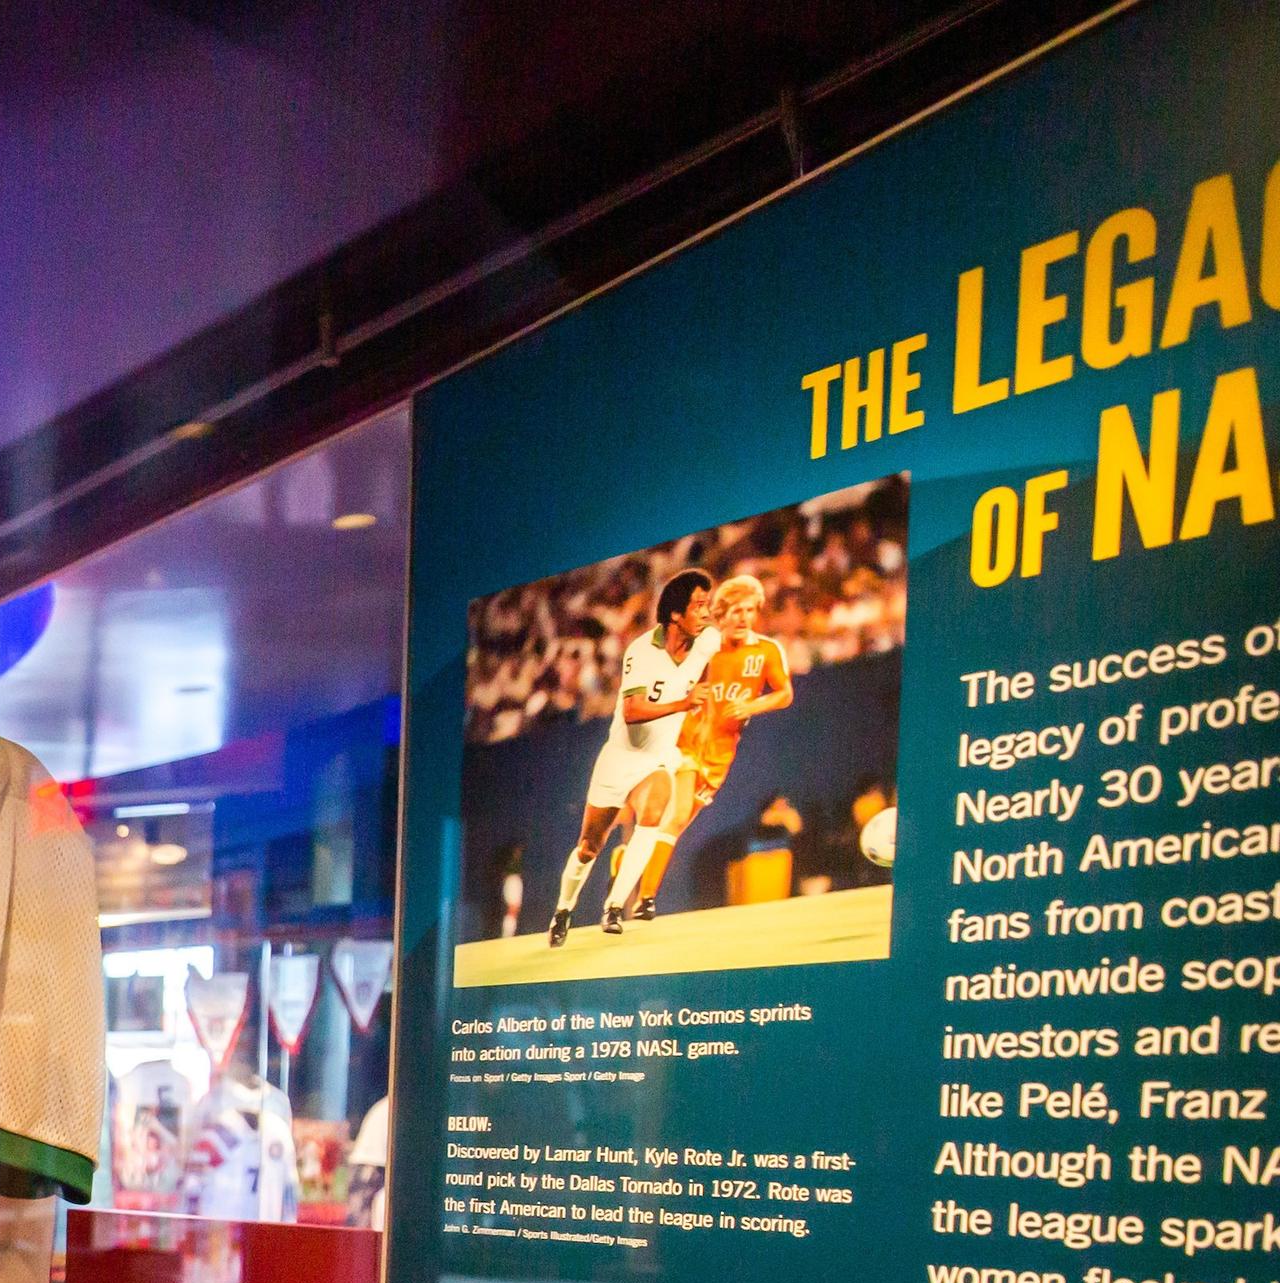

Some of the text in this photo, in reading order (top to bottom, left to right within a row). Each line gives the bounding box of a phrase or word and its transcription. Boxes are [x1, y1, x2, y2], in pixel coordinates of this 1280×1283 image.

[800, 160, 1280, 460] THE LEGA
[970, 367, 1279, 588] OF NA
[648, 681, 665, 702] 5
[960, 671, 1035, 707] The
[1049, 635, 1227, 692] success
[958, 685, 1280, 770] legacy of profe
[956, 756, 1280, 827] Nearly 30 year
[952, 844, 1063, 885] North
[948, 909, 1030, 943] fans
[1045, 899, 1143, 936] from
[945, 956, 1165, 1002] nationwide
[451, 1003, 812, 1035] Carlos Alberto of the New York Cosmos sprints
[942, 1023, 1120, 1059] investors
[1134, 1015, 1221, 1057] and
[451, 1039, 739, 1063] into action during a 1978 NASL game.
[447, 1116, 492, 1132] BELOW:
[940, 1080, 1268, 1125] like Pelé, Franz
[447, 1143, 856, 1171] Discovered by Lamar Hunt, Kyle Rote Jr. was a first-
[934, 1141, 1112, 1188] Although
[1128, 1145, 1202, 1184] the
[445, 1171, 853, 1204] round pick by the Dallas Tornado in 1972. Rote was
[444, 1197, 810, 1238] the first American to lead the league in scoring.
[931, 1199, 992, 1236] the
[1008, 1202, 1144, 1249] league
